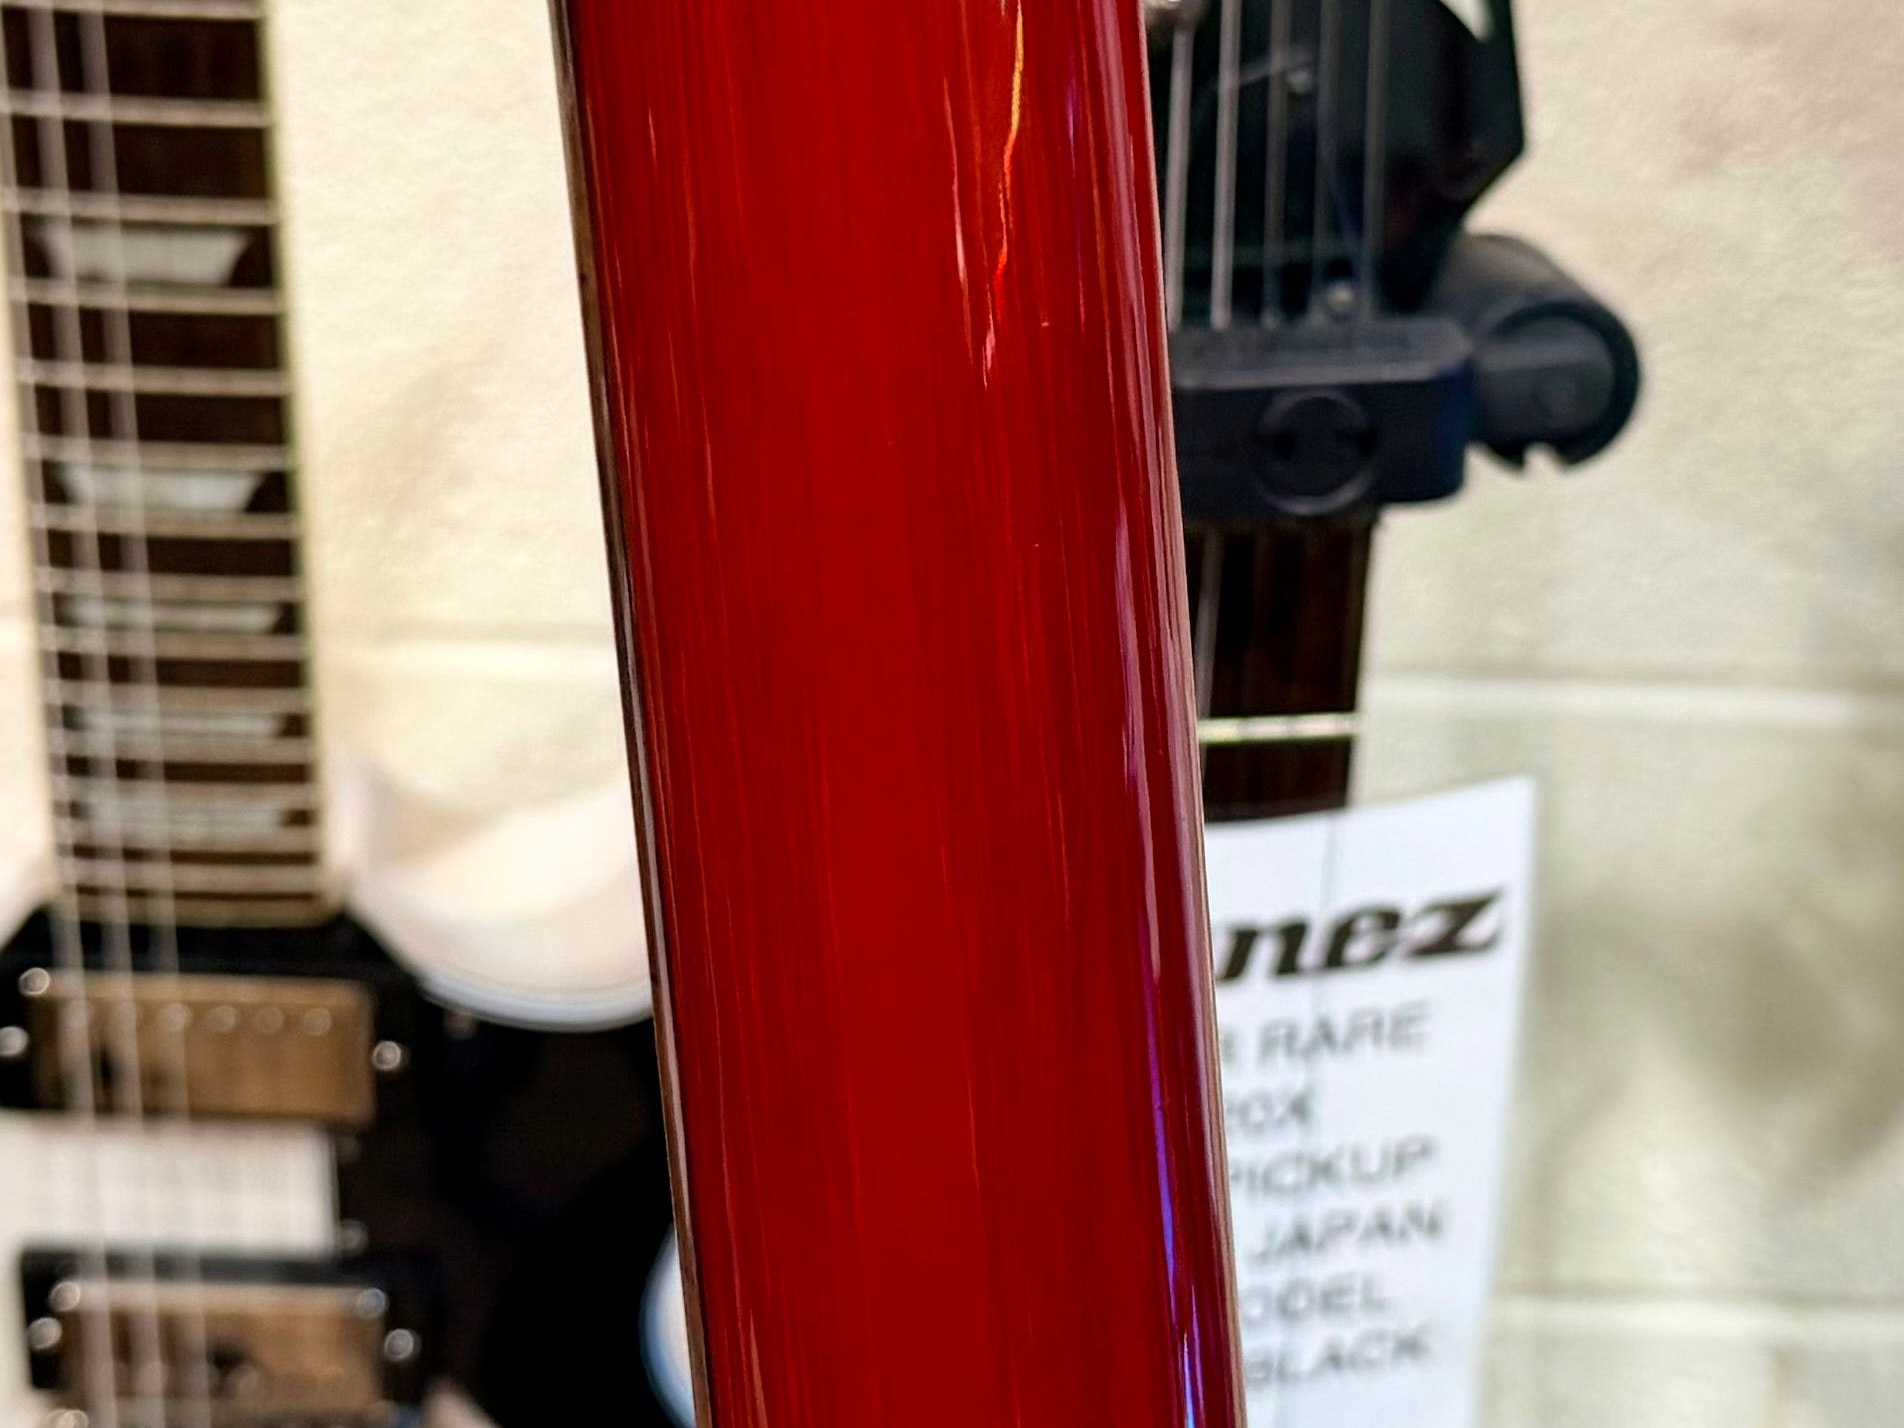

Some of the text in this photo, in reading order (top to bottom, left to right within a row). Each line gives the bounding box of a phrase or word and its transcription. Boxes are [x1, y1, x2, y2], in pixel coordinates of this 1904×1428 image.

[1215, 884, 1508, 986] nez
[1257, 997, 1433, 1067] RARE
[1247, 1196, 1449, 1268] JAPAN
[1239, 1272, 1394, 1329] ODEL
